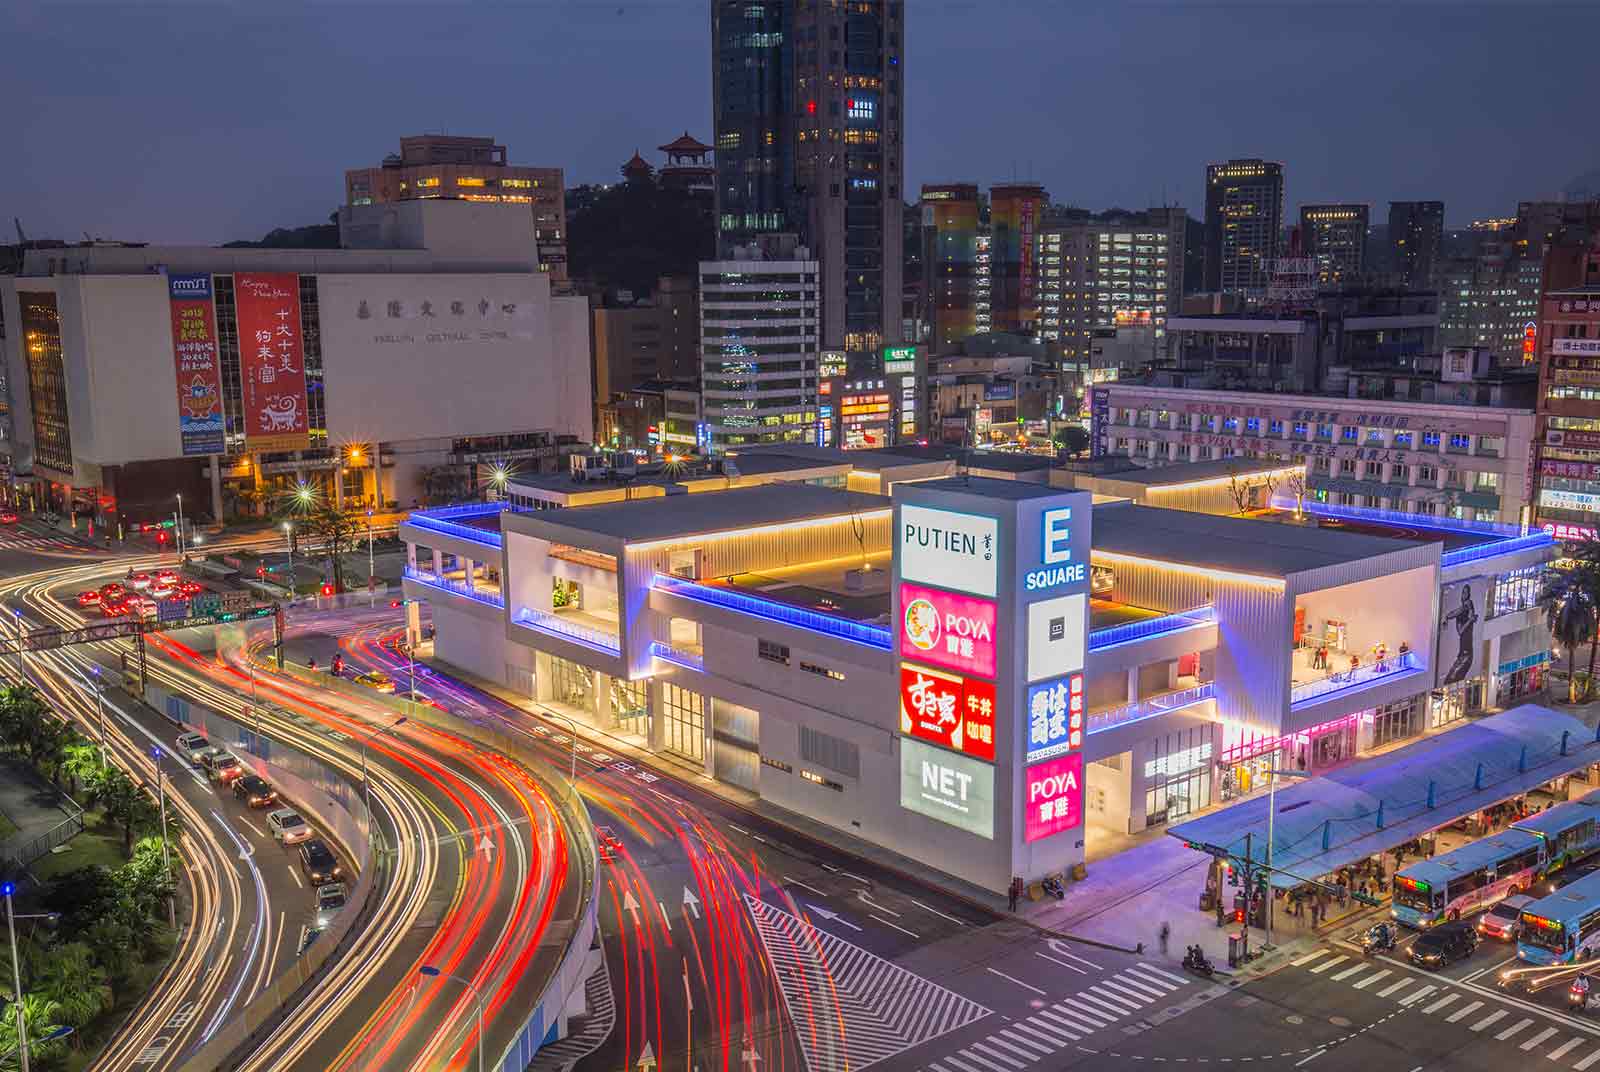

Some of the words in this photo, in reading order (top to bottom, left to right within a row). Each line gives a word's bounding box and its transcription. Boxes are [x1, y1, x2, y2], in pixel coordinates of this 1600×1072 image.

[906, 524, 976, 555] PUTIEN
[1043, 507, 1071, 564] E
[1026, 564, 1085, 590] SQUARE
[946, 613, 991, 642] POYA
[907, 673, 956, 725] すき家
[922, 760, 972, 801] NET
[1031, 771, 1077, 802] POYA
